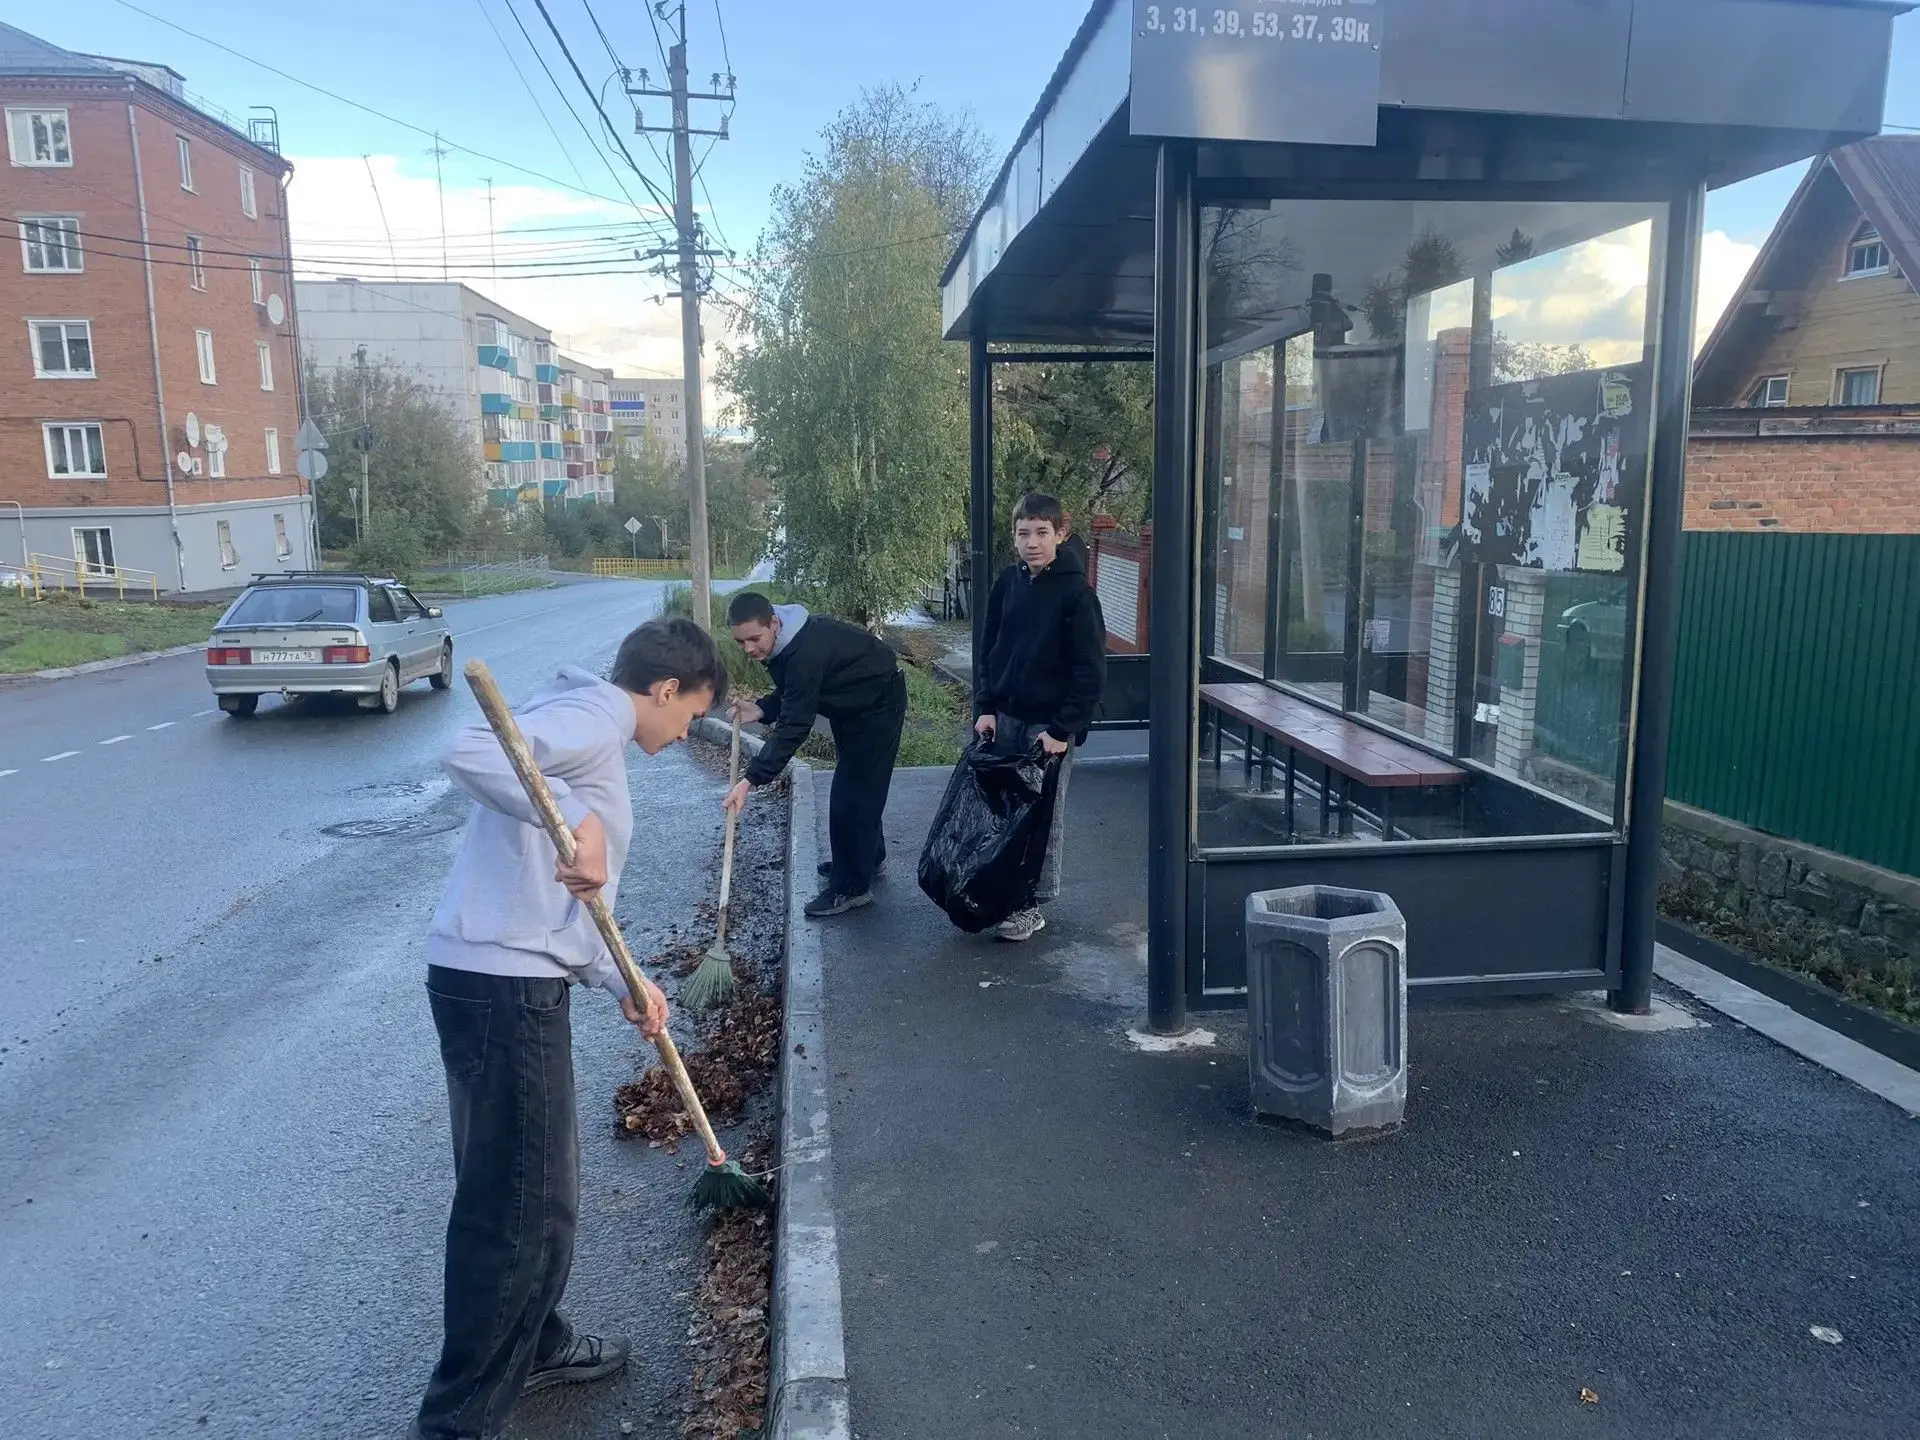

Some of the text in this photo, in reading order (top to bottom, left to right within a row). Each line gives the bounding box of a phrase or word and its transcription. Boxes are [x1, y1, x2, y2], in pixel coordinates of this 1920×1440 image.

[1146, 5, 1166, 34] 3,
[1172, 7, 1205, 36] 31,
[1213, 9, 1245, 38] 39,
[1252, 12, 1284, 41] 53,
[1292, 14, 1323, 42] 37,
